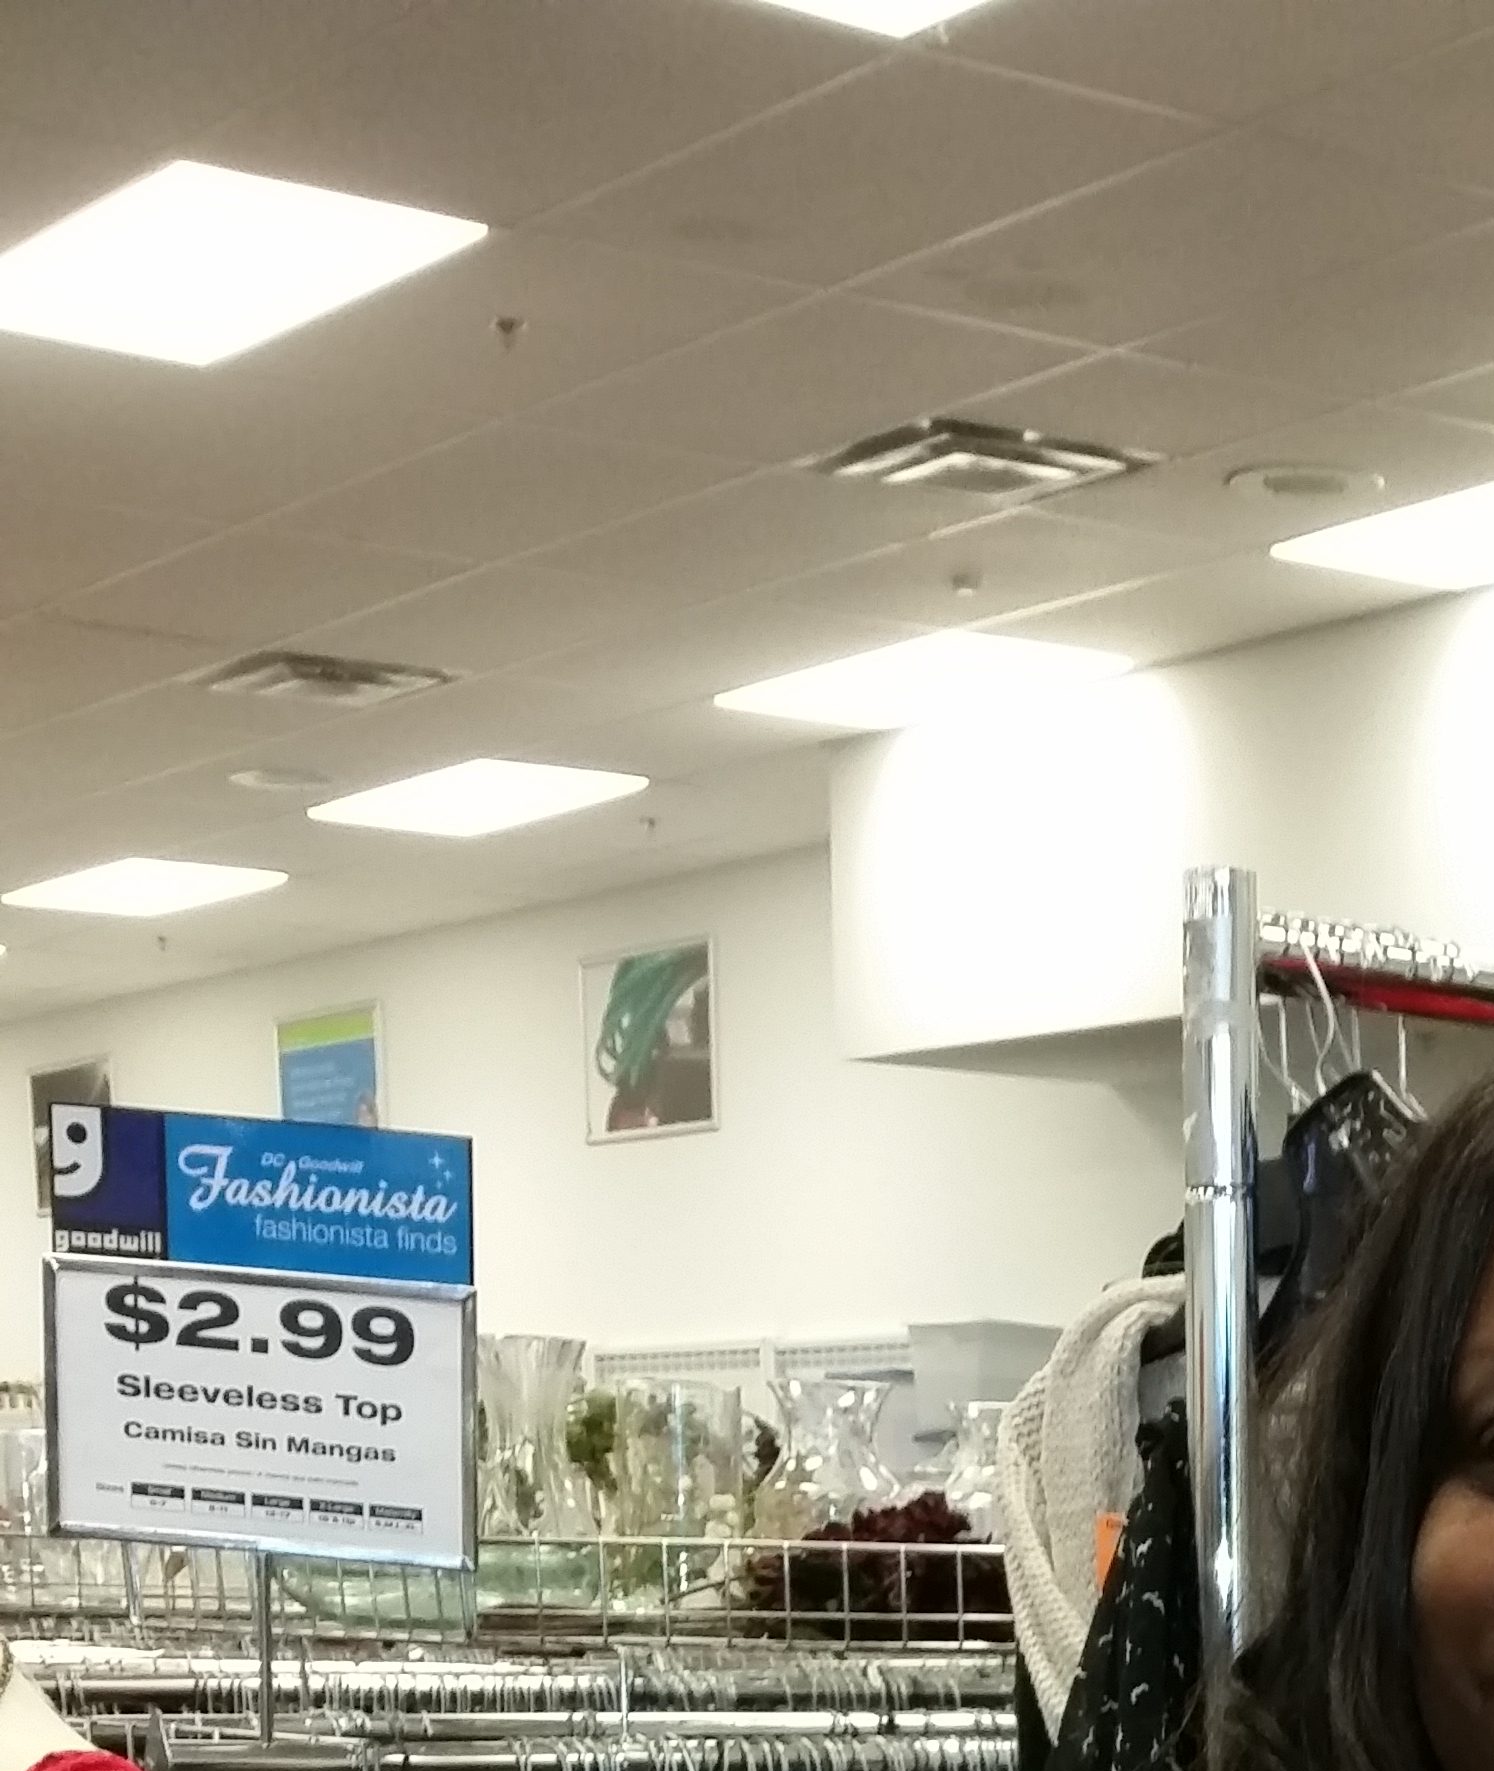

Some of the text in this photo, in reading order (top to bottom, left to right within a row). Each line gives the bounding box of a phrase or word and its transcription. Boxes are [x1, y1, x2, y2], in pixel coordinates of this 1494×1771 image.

[177, 1143, 458, 1224] Fashionista
[261, 1151, 365, 1174] DC Goodwill
[55, 1228, 162, 1253] goodwill
[254, 1214, 458, 1255] fashionista finds
[104, 1276, 415, 1366] $2.99
[117, 1373, 402, 1426] Sleeveless Top
[123, 1420, 397, 1463] Camisa Sin Mangas
